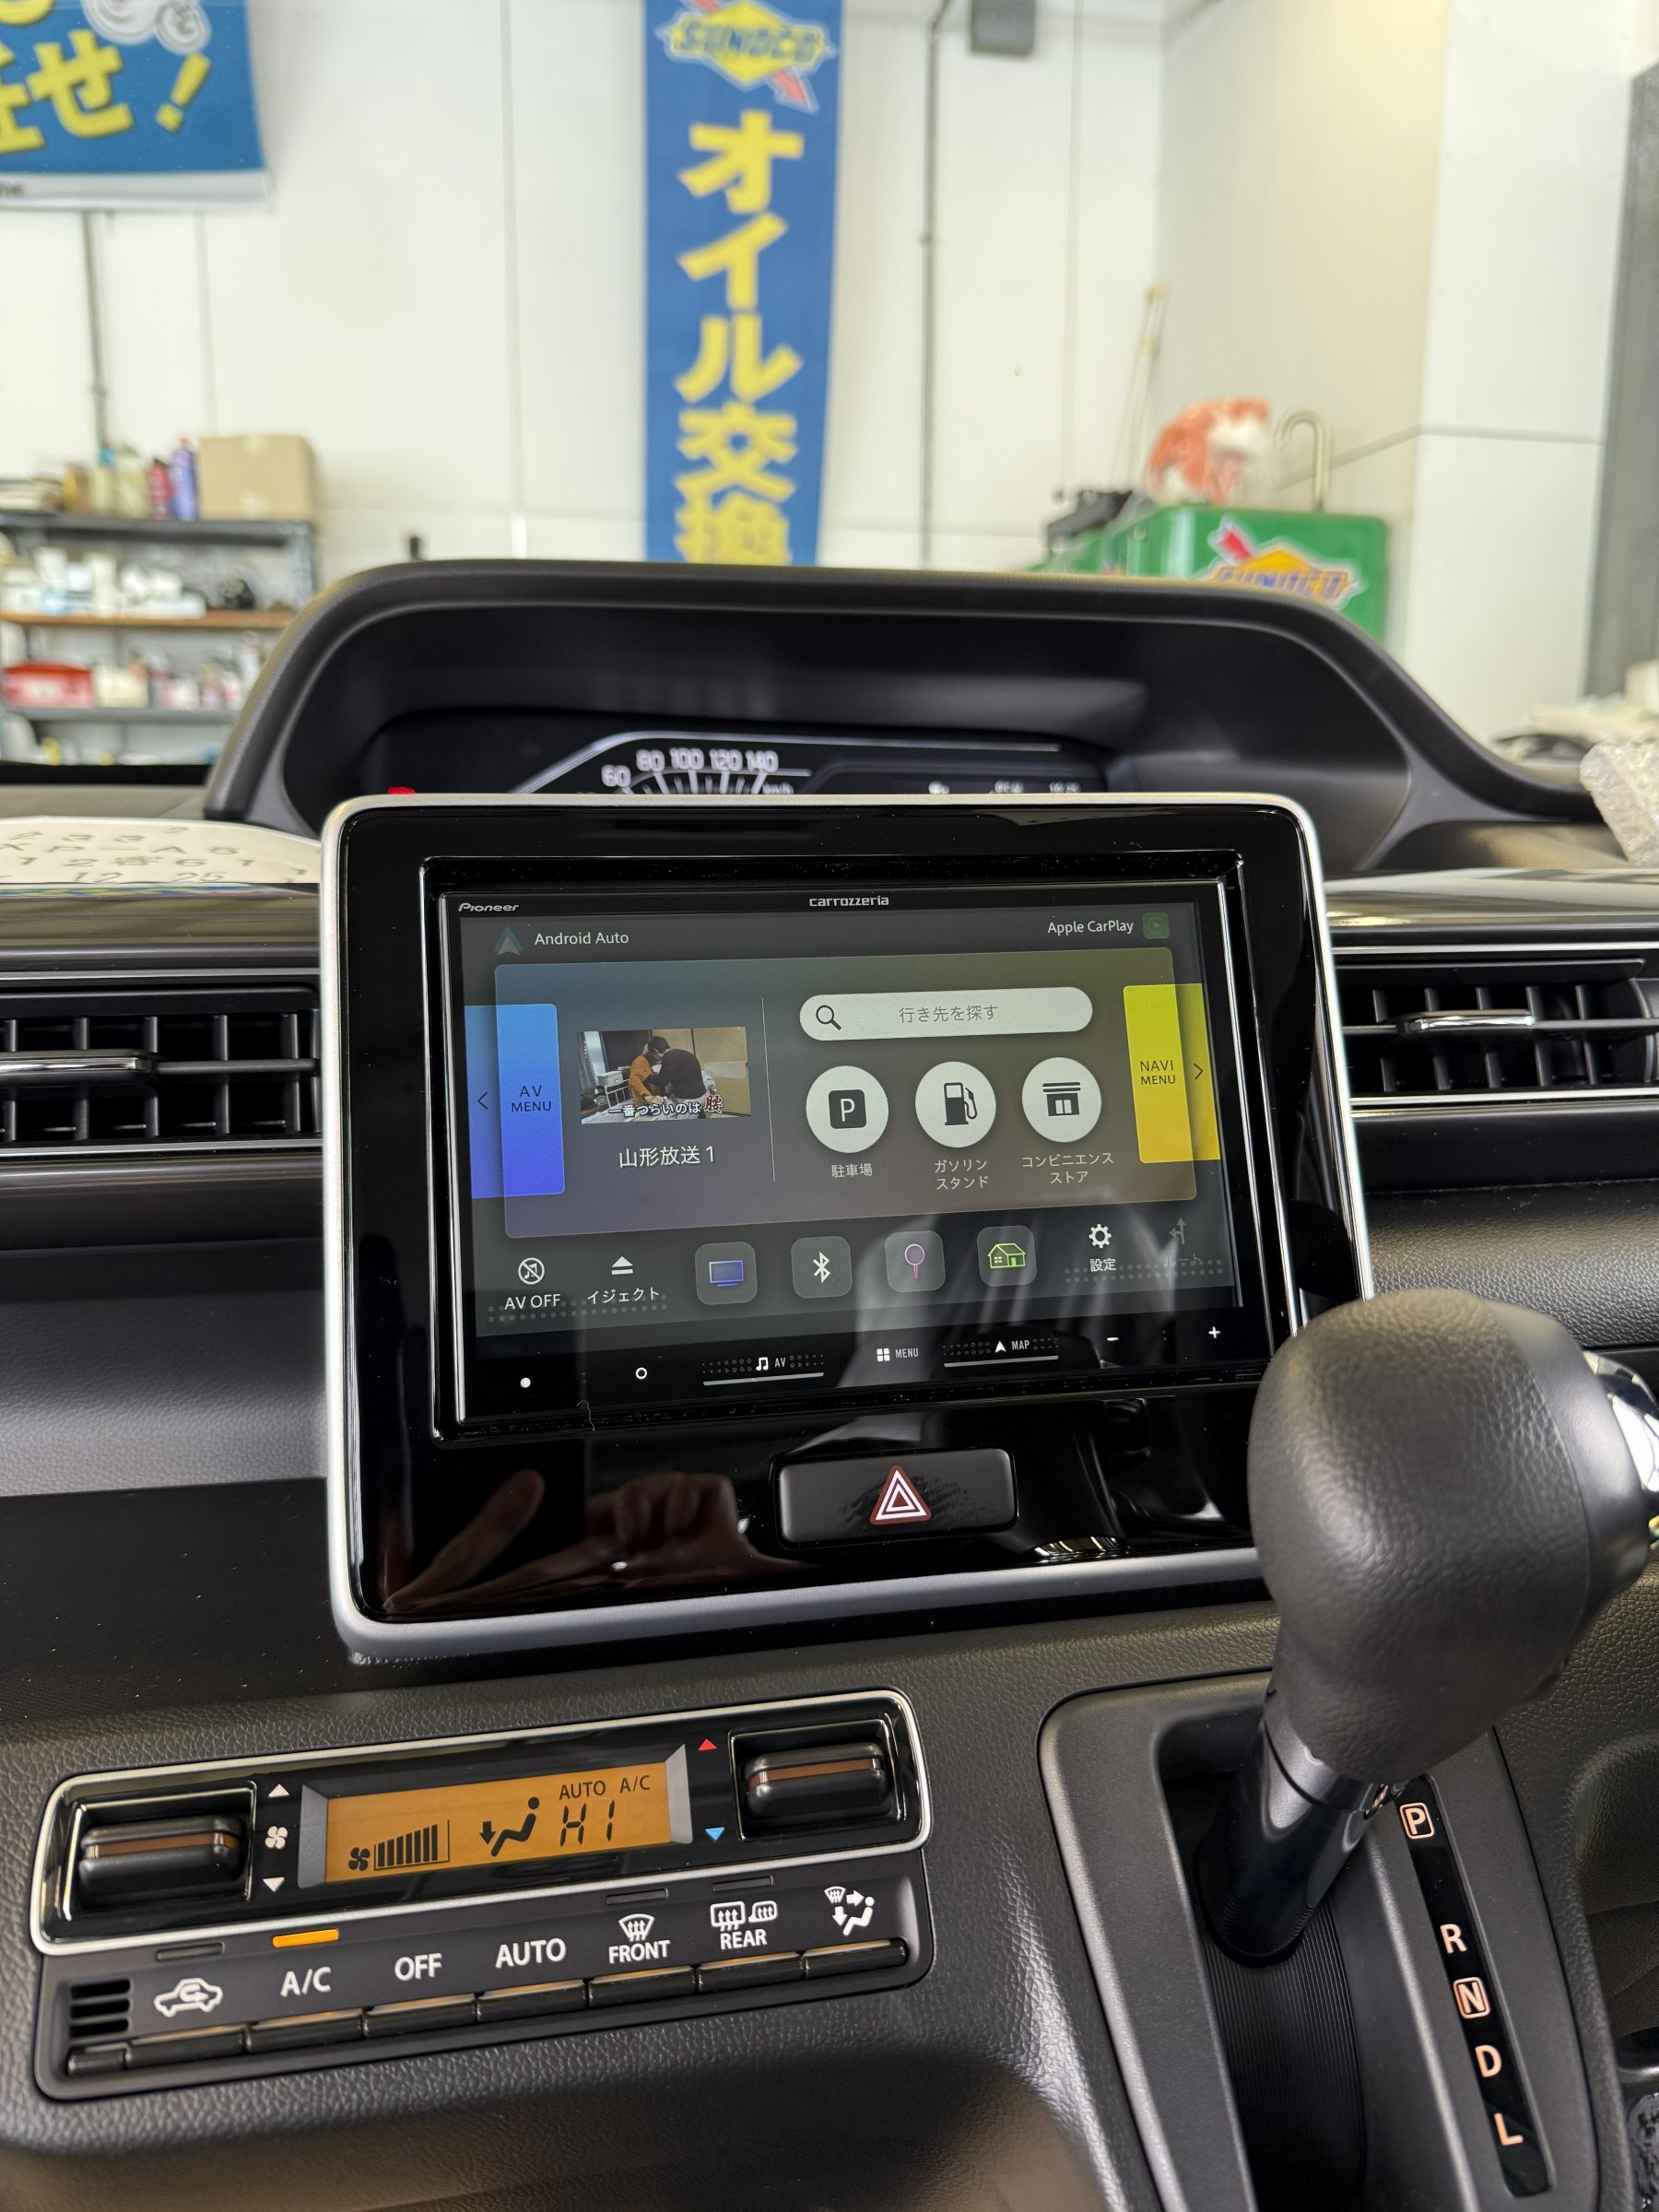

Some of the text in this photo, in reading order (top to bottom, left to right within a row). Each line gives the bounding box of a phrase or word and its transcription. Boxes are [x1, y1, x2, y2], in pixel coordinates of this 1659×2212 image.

[636, 748, 665, 772] 80
[669, 747, 704, 771] 100
[709, 748, 743, 771] 120
[745, 749, 778, 773] 140
[601, 764, 631, 787] 60
[458, 902, 519, 912] Pioneer
[809, 895, 889, 908] carrozzeria
[1048, 919, 1134, 935] Apple CarPlay
[535, 931, 629, 946] Android Auto
[899, 1004, 999, 1023] 行き先を探す
[1139, 1059, 1174, 1072] NAVI
[1140, 1074, 1176, 1086] MENU
[519, 1085, 542, 1098] AV
[511, 1100, 552, 1112] MENU
[608, 1102, 700, 1117] 一番つらいのは
[619, 1146, 715, 1168] 山形放送 1
[935, 1159, 988, 1173] ガソリン
[1022, 1152, 1114, 1168] コンビニエンス
[831, 1163, 873, 1178] 駐車場
[1050, 1171, 1088, 1185] ストア
[935, 1175, 989, 1190] スタンド
[1089, 1257, 1117, 1272] 設定
[504, 1293, 561, 1310] AV OFF
[587, 1286, 660, 1305] イジェクト
[895, 1347, 919, 1359] MENU
[1011, 1340, 1030, 1351] MAP
[774, 1358, 786, 1368] AV
[559, 1774, 651, 1800] AUTO A/C
[1406, 1806, 1426, 1835] P
[720, 1929, 768, 1950] REAR
[1440, 1923, 1467, 1954] R
[495, 1938, 567, 1968] AUTO
[608, 1940, 671, 1964] FRONT
[394, 1953, 442, 1982] OFF
[280, 1966, 332, 1997] A/C
[1458, 1982, 1485, 2014] N
[1476, 2043, 1502, 2078] D
[1494, 2112, 1524, 2146] L
